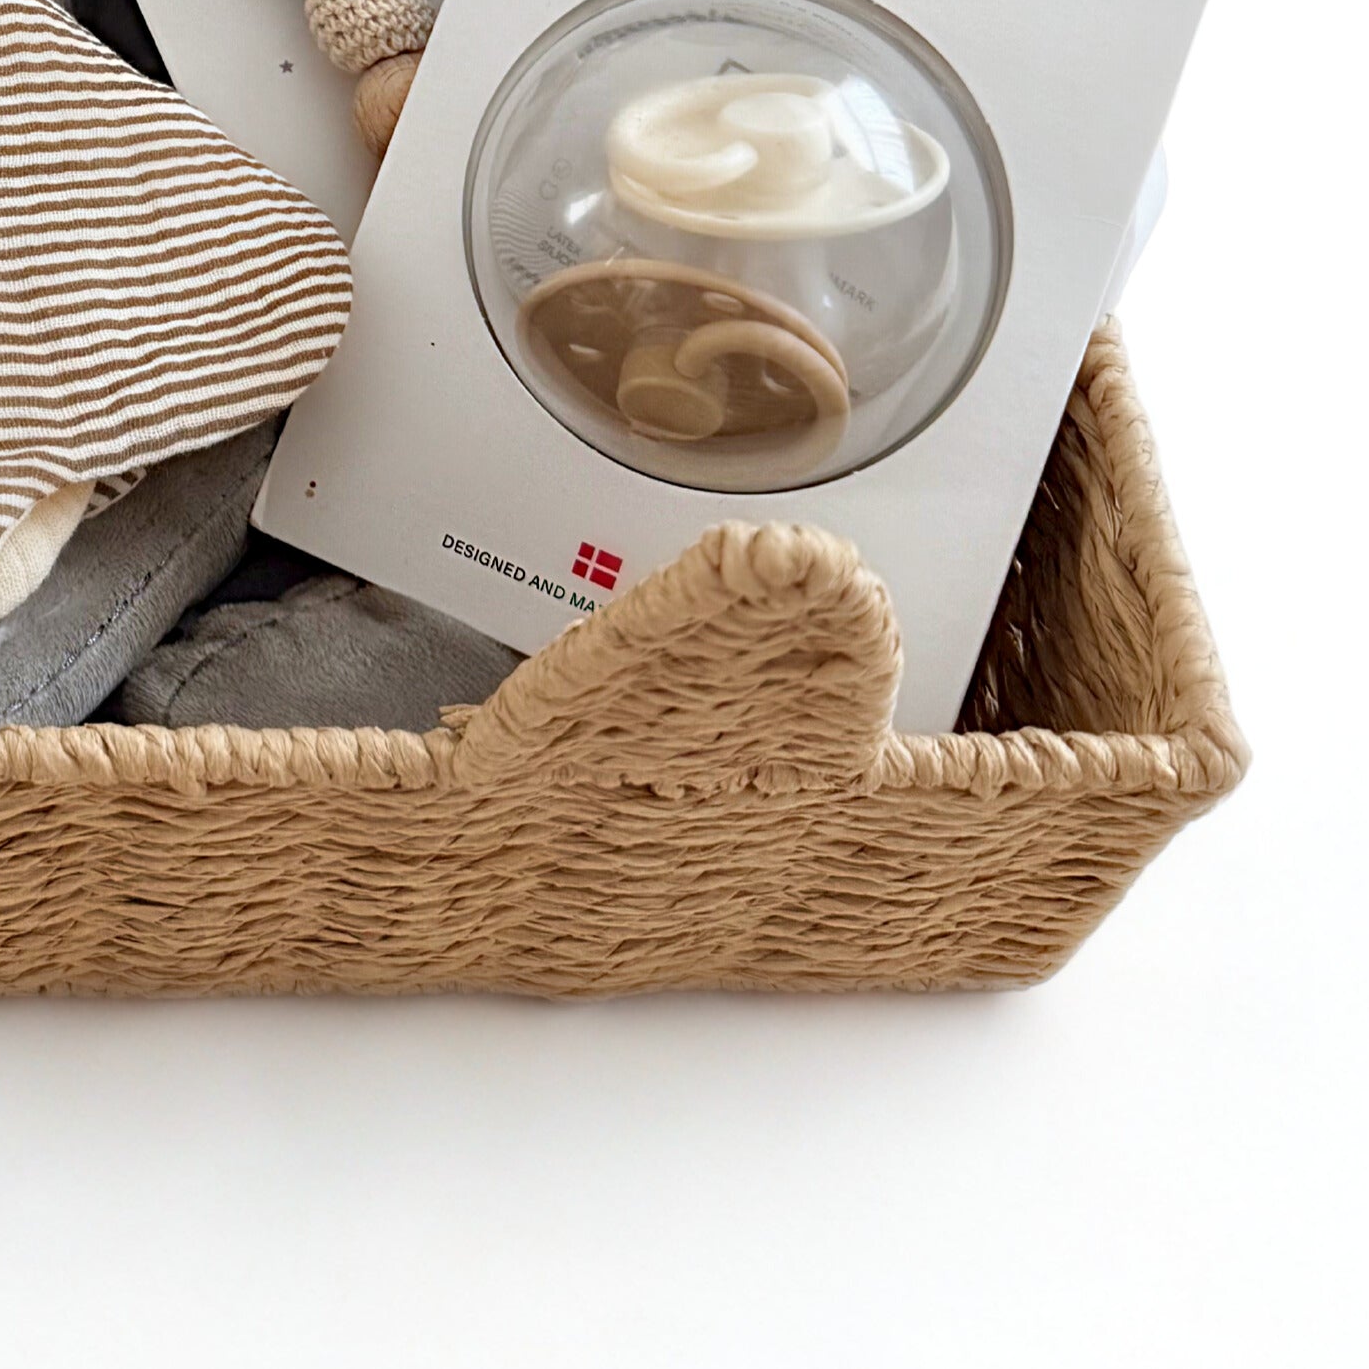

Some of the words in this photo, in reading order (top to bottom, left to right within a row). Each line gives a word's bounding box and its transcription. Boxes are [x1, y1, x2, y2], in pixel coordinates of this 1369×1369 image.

[441, 533, 526, 582] DESIGNED
[528, 574, 566, 600] AND
[569, 592, 603, 613] MA
